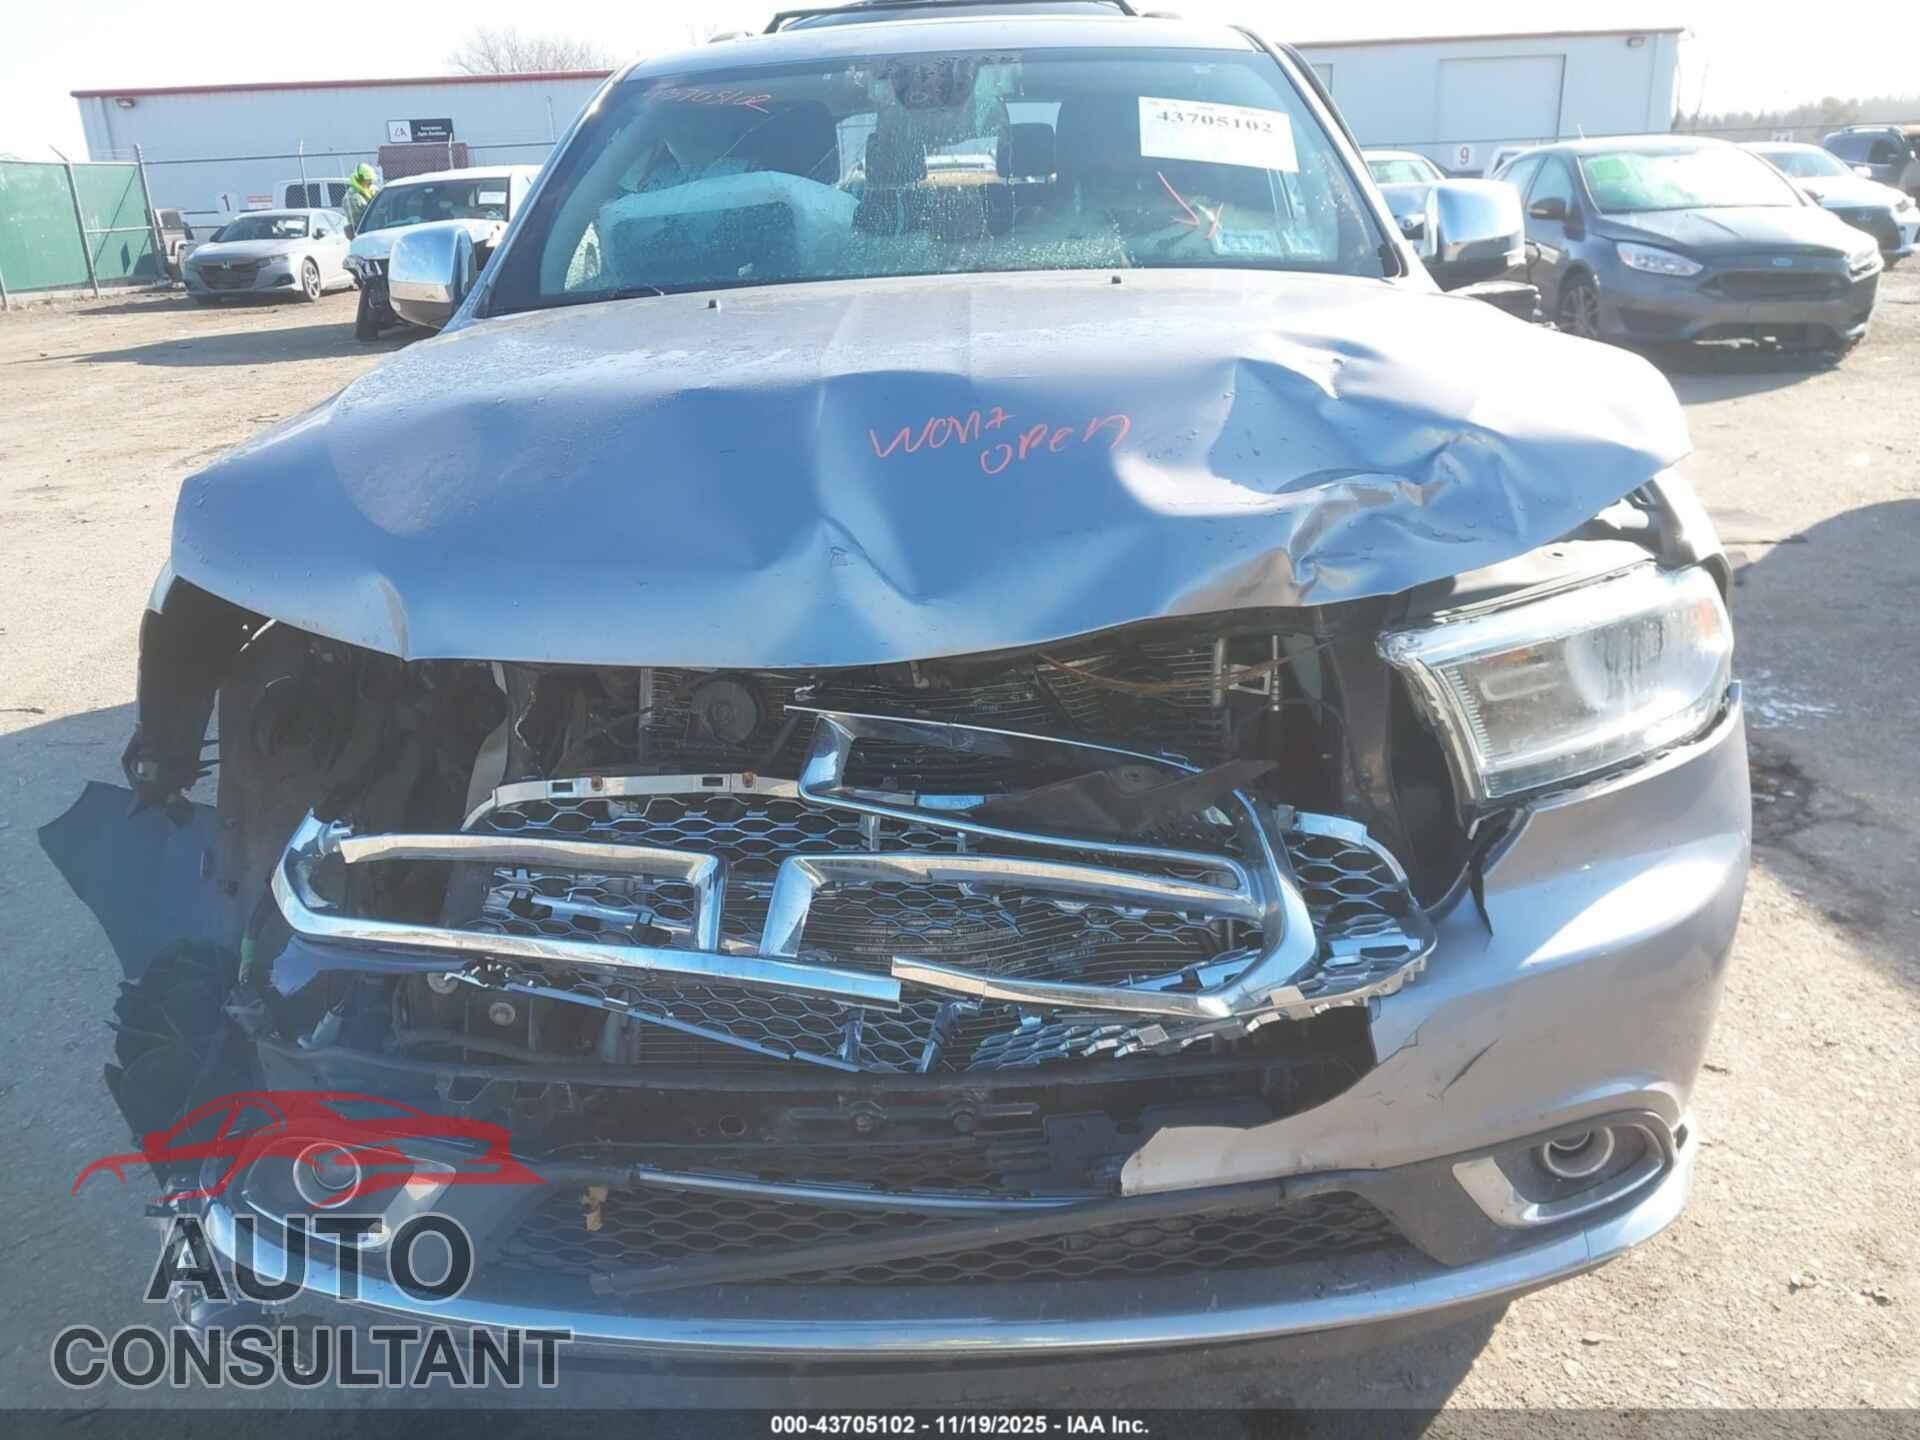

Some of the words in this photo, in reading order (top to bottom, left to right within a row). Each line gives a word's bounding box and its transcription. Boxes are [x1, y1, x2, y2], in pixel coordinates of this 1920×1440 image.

[1156, 111, 1273, 133] 43705102
[1460, 146, 1469, 165] 9
[221, 194, 230, 211] 1
